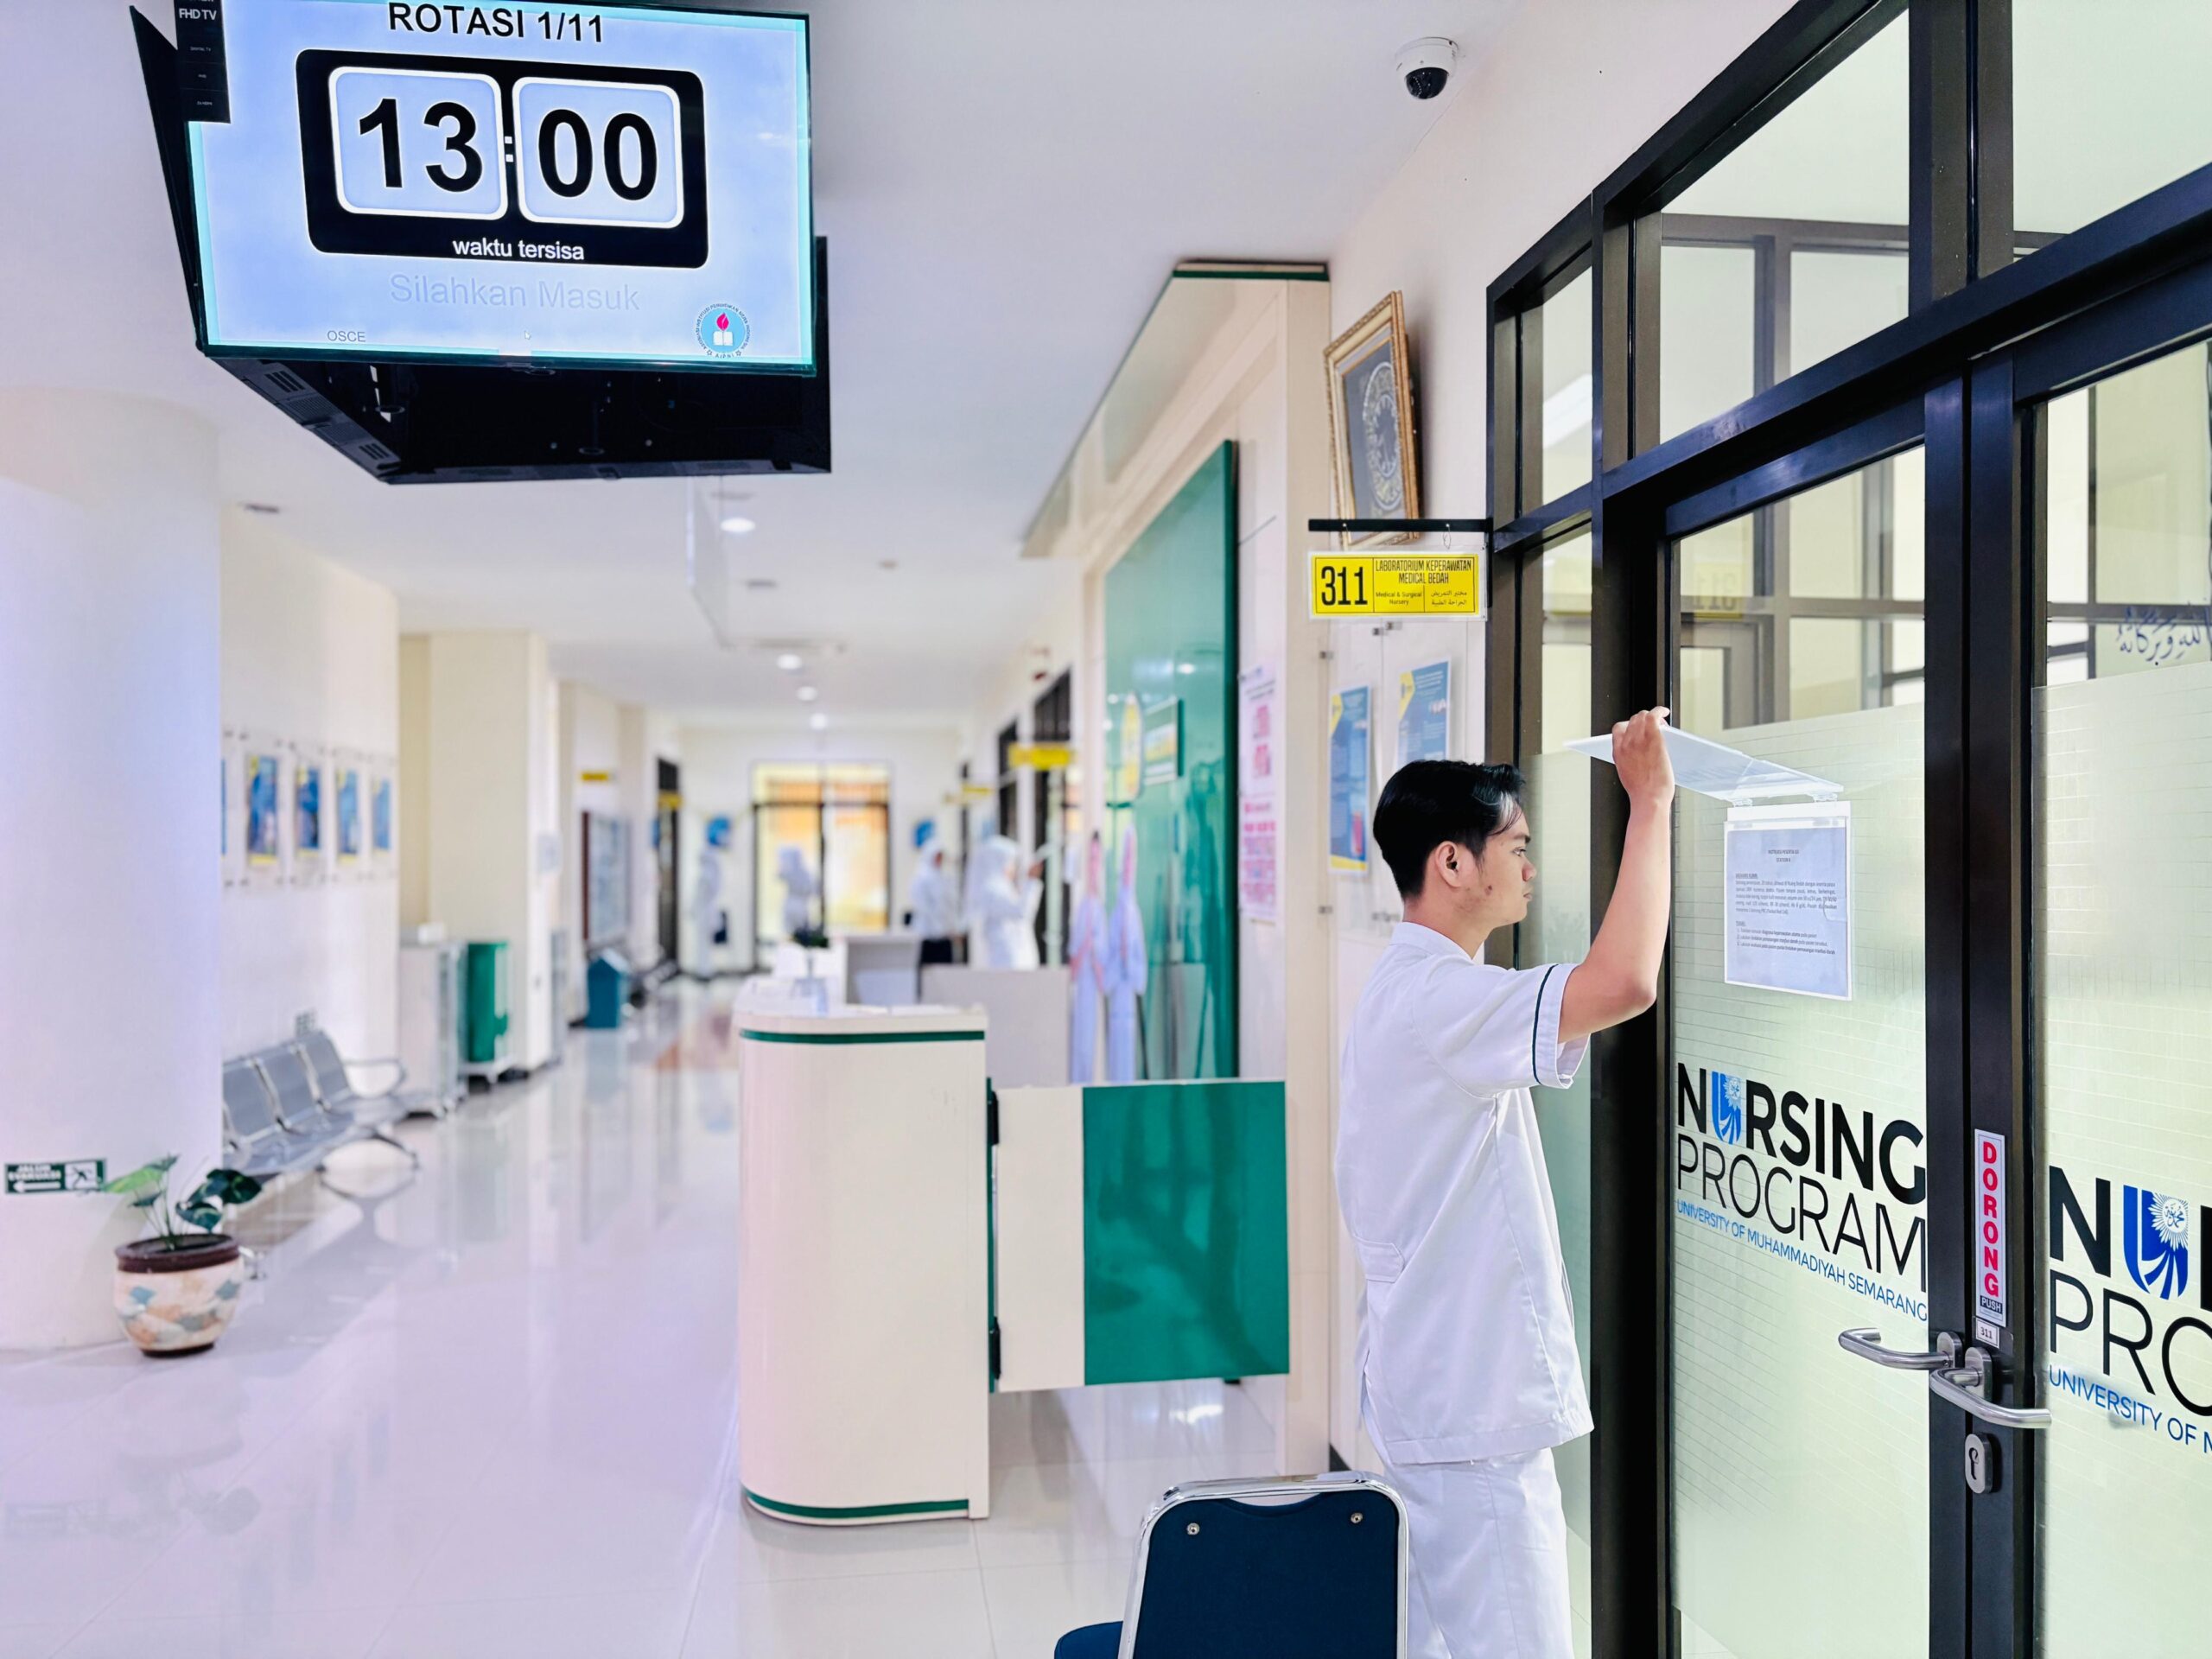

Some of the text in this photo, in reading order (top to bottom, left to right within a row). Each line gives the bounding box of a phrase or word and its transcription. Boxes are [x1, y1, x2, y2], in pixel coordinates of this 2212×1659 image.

[179, 8, 217, 20] FHD TV
[389, 3, 601, 42] ROTASI 1/11
[453, 238, 584, 260] waktu tersisa
[391, 274, 640, 311] Silahkan Masuk
[327, 330, 366, 342] OSCE
[1376, 560, 1471, 571] LABORATORIUM KEPERAWATAN
[1399, 573, 1449, 584] MEDICAL BEDAH
[1321, 566, 1367, 605] 311
[1677, 1062, 1926, 1205] NURSING
[1677, 1133, 1927, 1294] PROGRAM
[1982, 1141, 1999, 1297] DORONG
[1677, 1198, 1928, 1321] UNIVERSITY OF MUHAMMADIYAH SEMARANG
[1982, 1297, 2001, 1313] PUSH
[1980, 1326, 1993, 1339] 311
[2050, 1364, 2163, 1432] UNIVERSITY
[2167, 1417, 2196, 1446] OF
